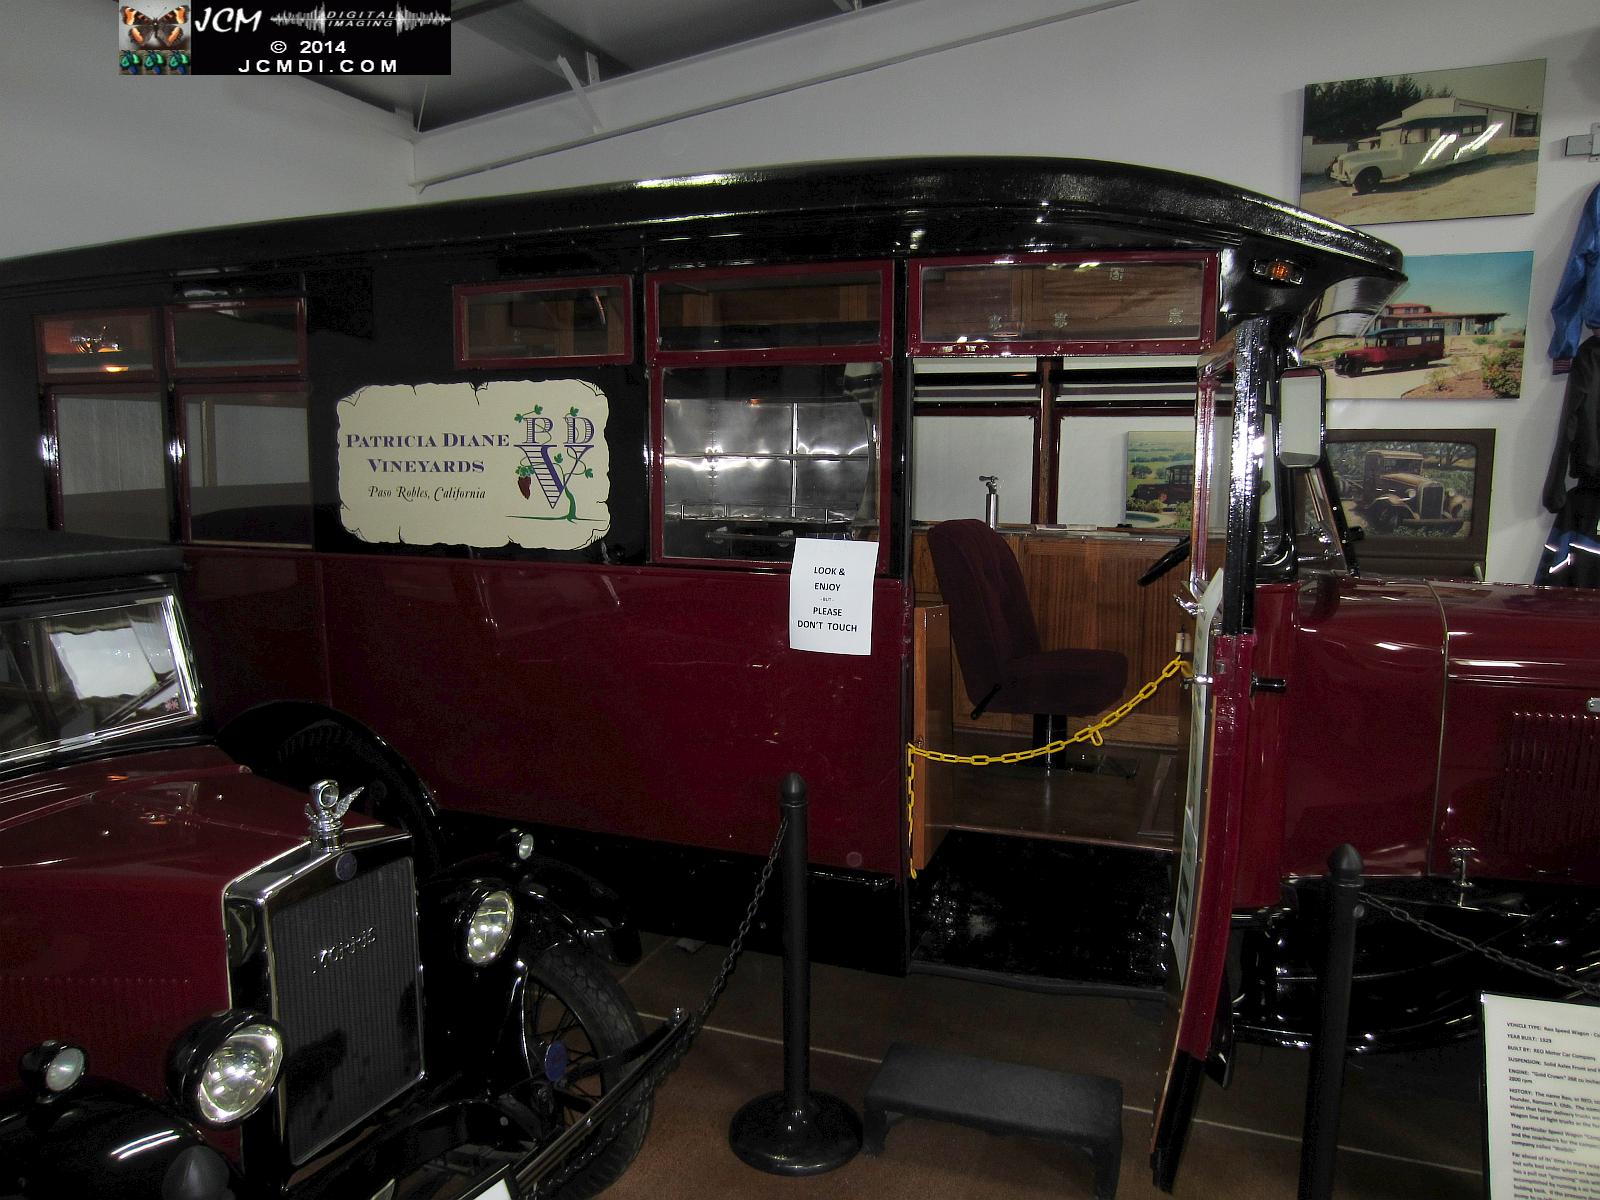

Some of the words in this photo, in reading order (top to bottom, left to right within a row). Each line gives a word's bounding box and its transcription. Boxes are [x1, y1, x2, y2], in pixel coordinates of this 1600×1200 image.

[346, 433, 437, 449] PATRICIA
[442, 432, 510, 448] DIANE
[367, 458, 485, 474] VINEYARDS
[367, 485, 392, 498] Paso
[397, 486, 430, 502] Robles,
[434, 486, 486, 502] California
[814, 566, 837, 576] LOOK
[838, 567, 846, 576] &
[814, 582, 841, 591] ENJOY
[813, 606, 842, 616] PLEASE
[797, 620, 823, 629] DON'T
[827, 622, 857, 632] TOUCH
[1508, 1057, 1541, 1065] SUSPENSION:
